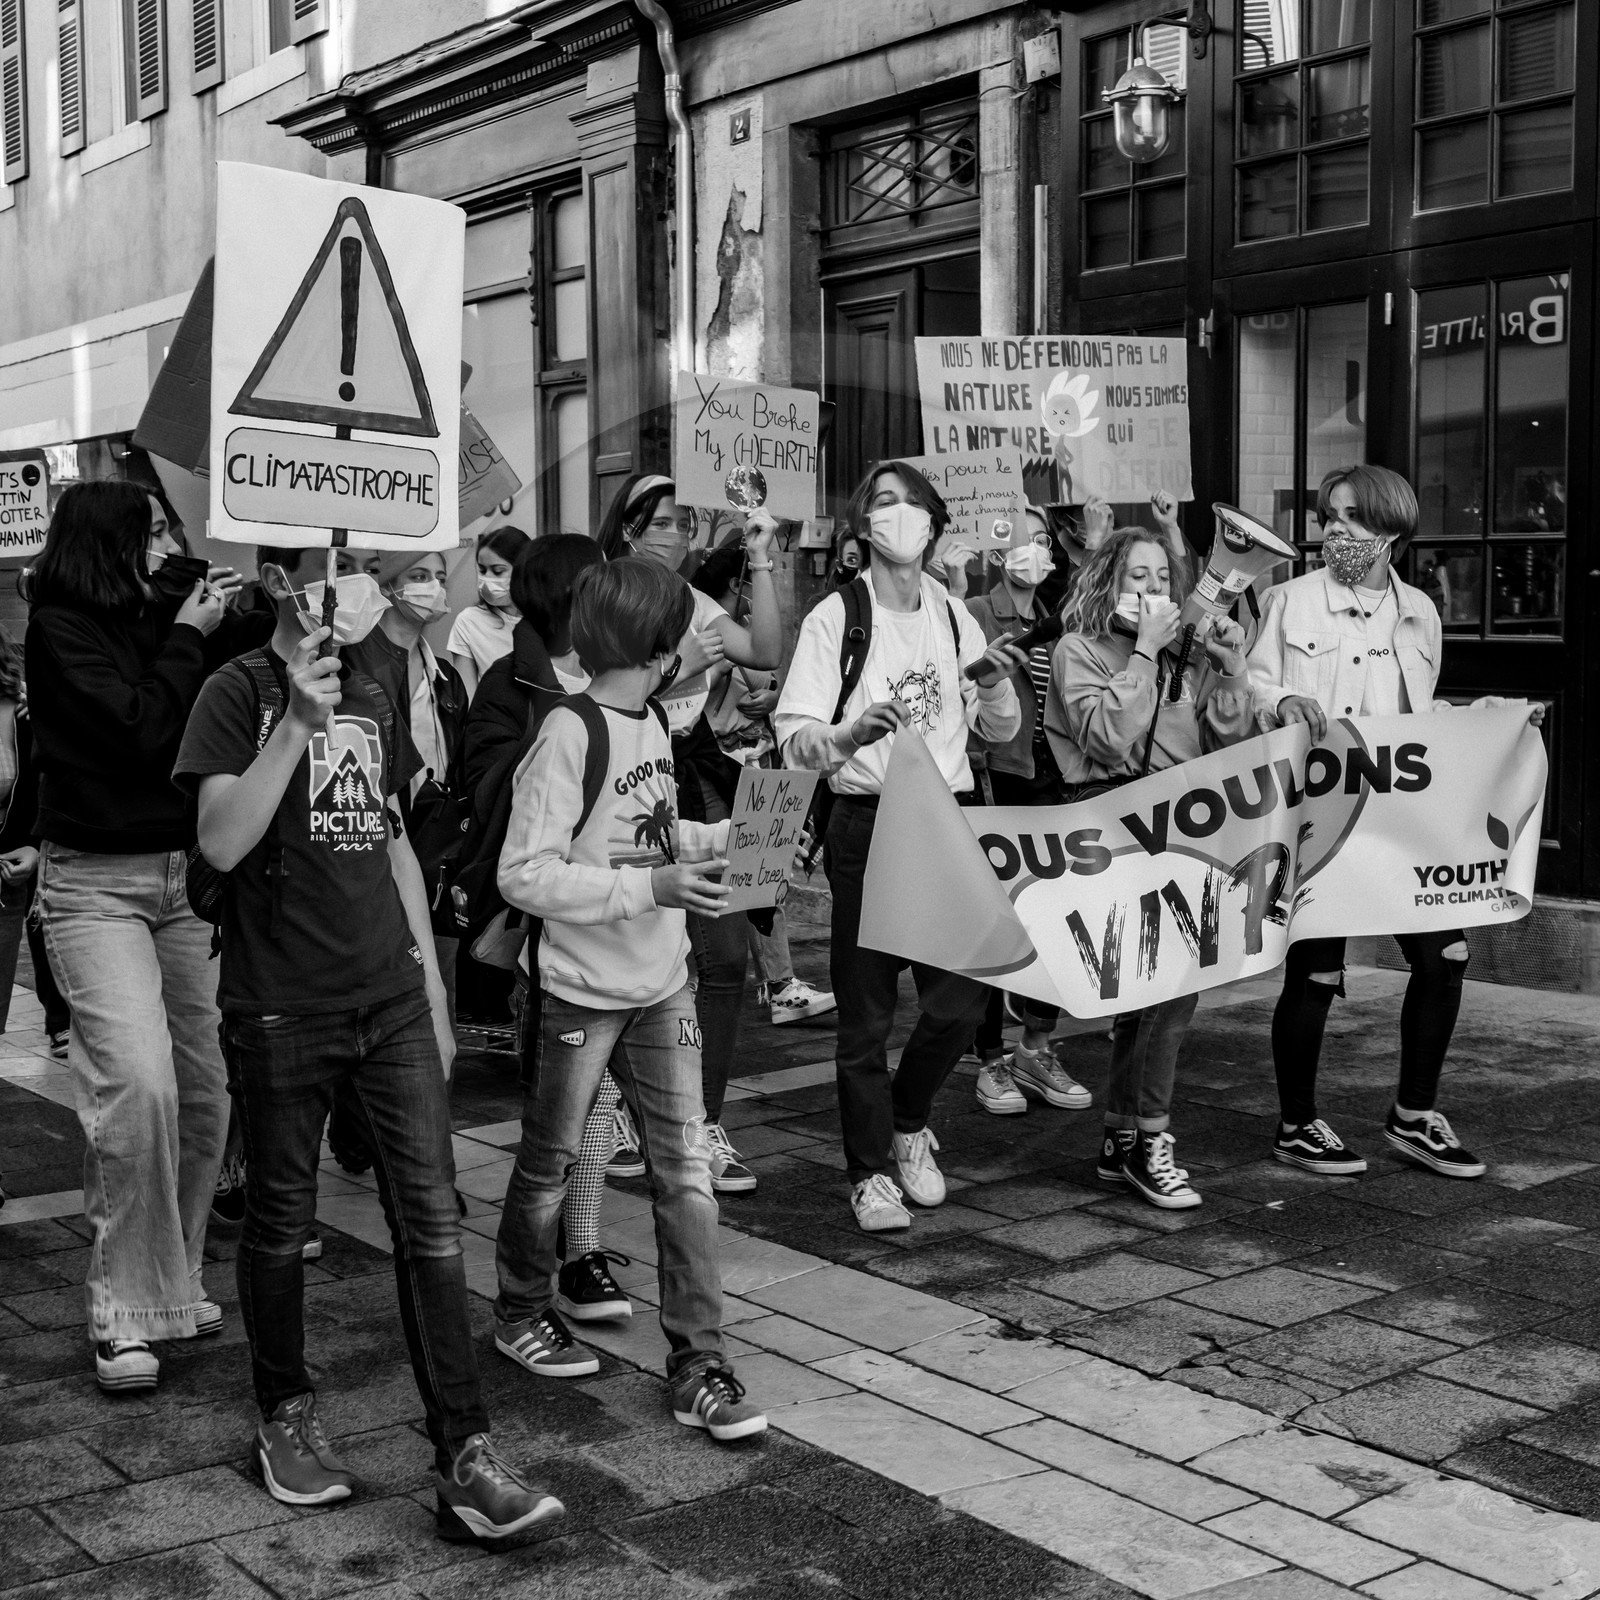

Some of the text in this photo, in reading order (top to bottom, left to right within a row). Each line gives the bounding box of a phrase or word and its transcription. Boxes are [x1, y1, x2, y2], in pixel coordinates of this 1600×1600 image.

[735, 116, 744, 139] 2
[940, 337, 1168, 371] NOUS NE DÉFENDONS PAS LA
[694, 376, 812, 433] You Broke
[944, 382, 1187, 412] NATURE NOUS SOMMES
[695, 429, 726, 472] My
[933, 424, 959, 454] LA
[966, 425, 1053, 456] NATURE
[1147, 417, 1180, 448] SE
[944, 465, 988, 487] pour
[996, 457, 1013, 473] le
[985, 490, 1019, 499] nous
[957, 504, 970, 517] de
[975, 504, 1020, 517] changer
[614, 761, 653, 796] GOOD
[745, 778, 803, 813] No More
[1119, 742, 1433, 857] VOULONS
[310, 811, 385, 833] PICTURE
[1413, 858, 1509, 888] YOUTH
[1414, 893, 1445, 907] FOR
[1491, 899, 1519, 913] GAP
